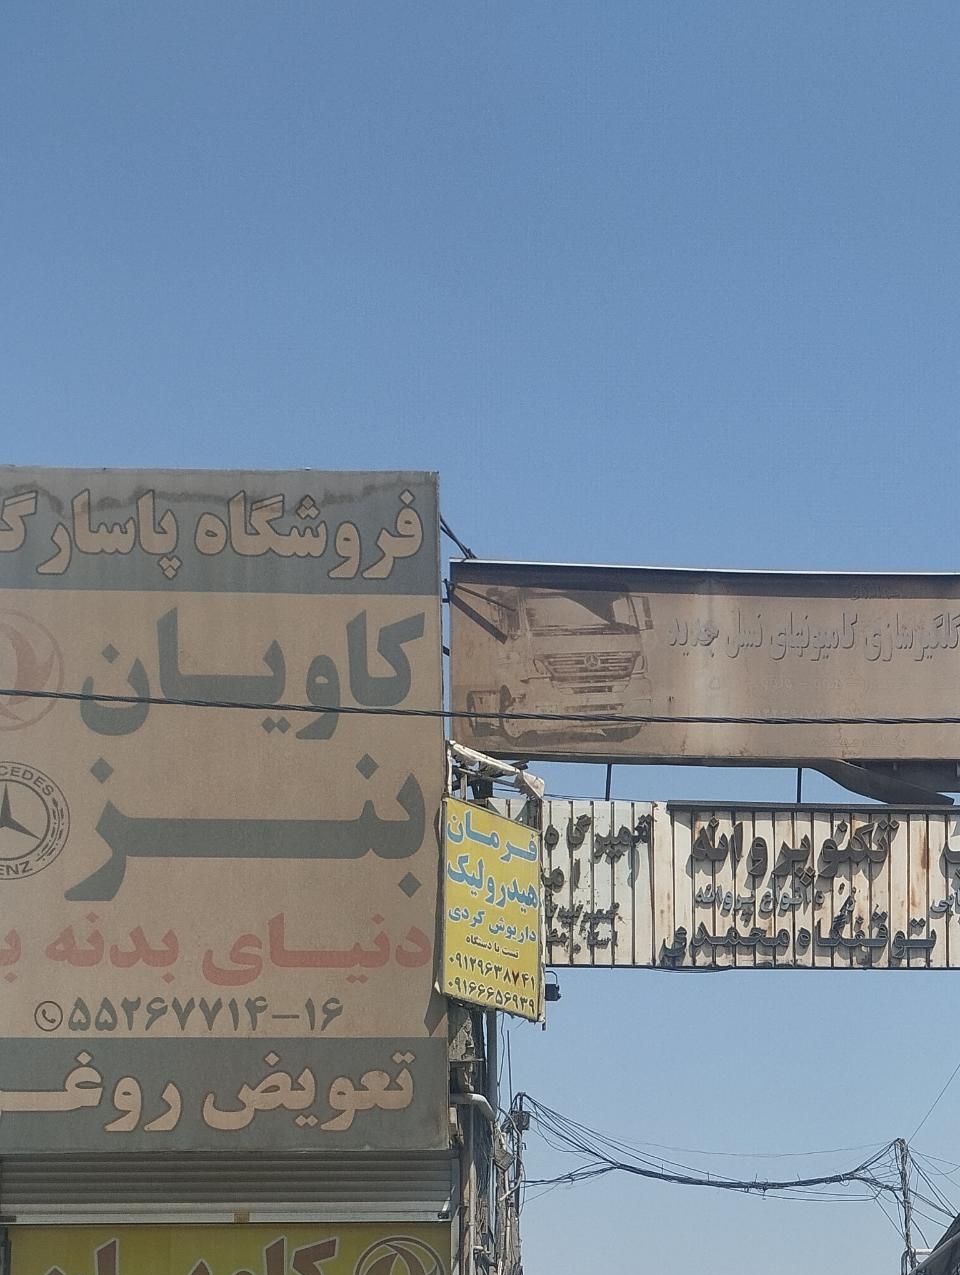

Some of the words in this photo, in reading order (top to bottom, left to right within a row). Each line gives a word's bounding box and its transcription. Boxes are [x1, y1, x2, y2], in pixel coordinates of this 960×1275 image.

[0, 487, 184, 580] پاسارگ
[194, 488, 425, 580] فروشگاه
[79, 606, 426, 741] کاویان
[64, 752, 427, 902] بنز
[447, 809, 539, 863] فرمان
[447, 853, 541, 915] هیدرولیک
[44, 911, 181, 985] بدنه
[202, 912, 433, 988] دنیای
[0, 1050, 182, 1133] روغ
[202, 1050, 417, 1133] تعویض
